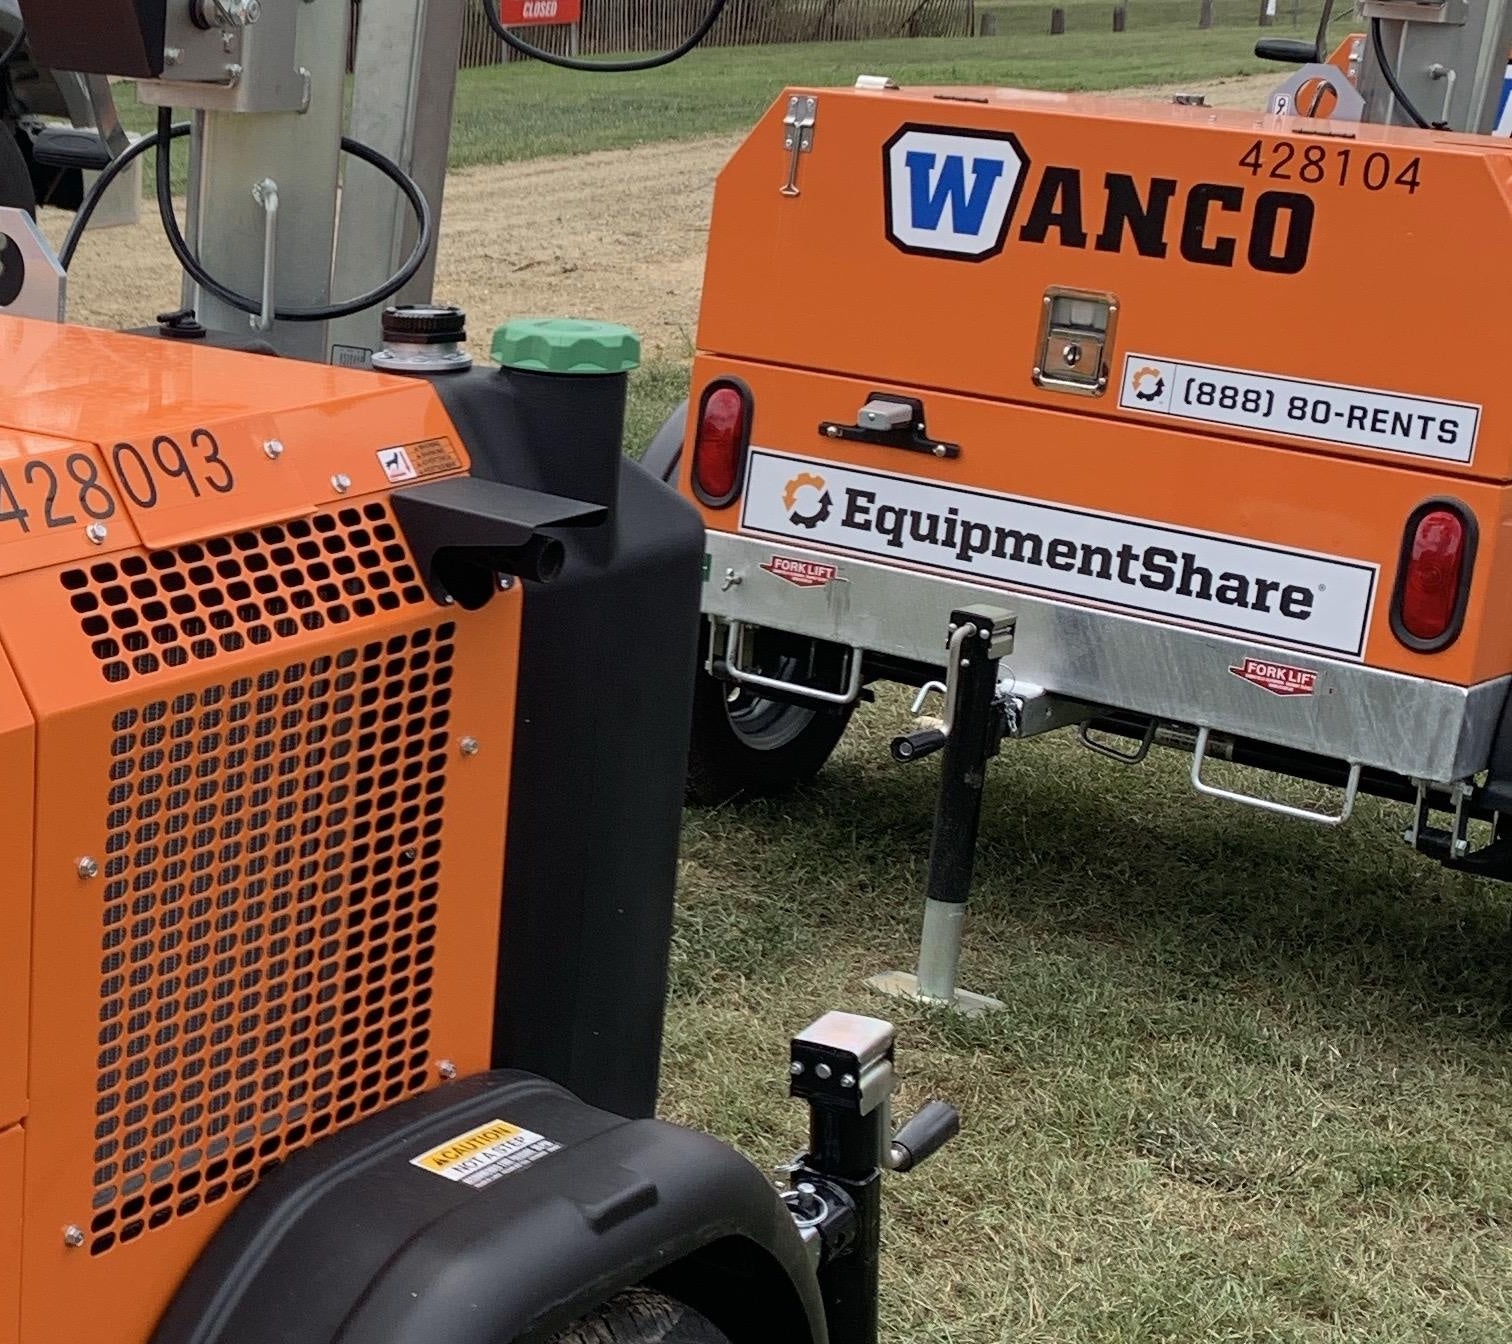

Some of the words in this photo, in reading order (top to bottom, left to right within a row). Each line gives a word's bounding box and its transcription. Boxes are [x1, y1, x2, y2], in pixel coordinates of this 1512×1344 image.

[522, 0, 558, 19] CLOSED
[1239, 140, 1422, 195] 428104
[904, 149, 1316, 274] WANCO
[1183, 376, 1274, 417] (888)
[1286, 395, 1459, 447] 80-RENTS
[774, 558, 806, 574] FORK
[806, 564, 833, 579] LIFT
[841, 487, 1316, 621] EquipmentShare
[1247, 661, 1286, 680] FORK
[442, 1126, 512, 1165] CAUTION
[452, 1155, 483, 1175] NOT
[482, 1150, 495, 1162] A
[495, 1135, 526, 1157] STEP
